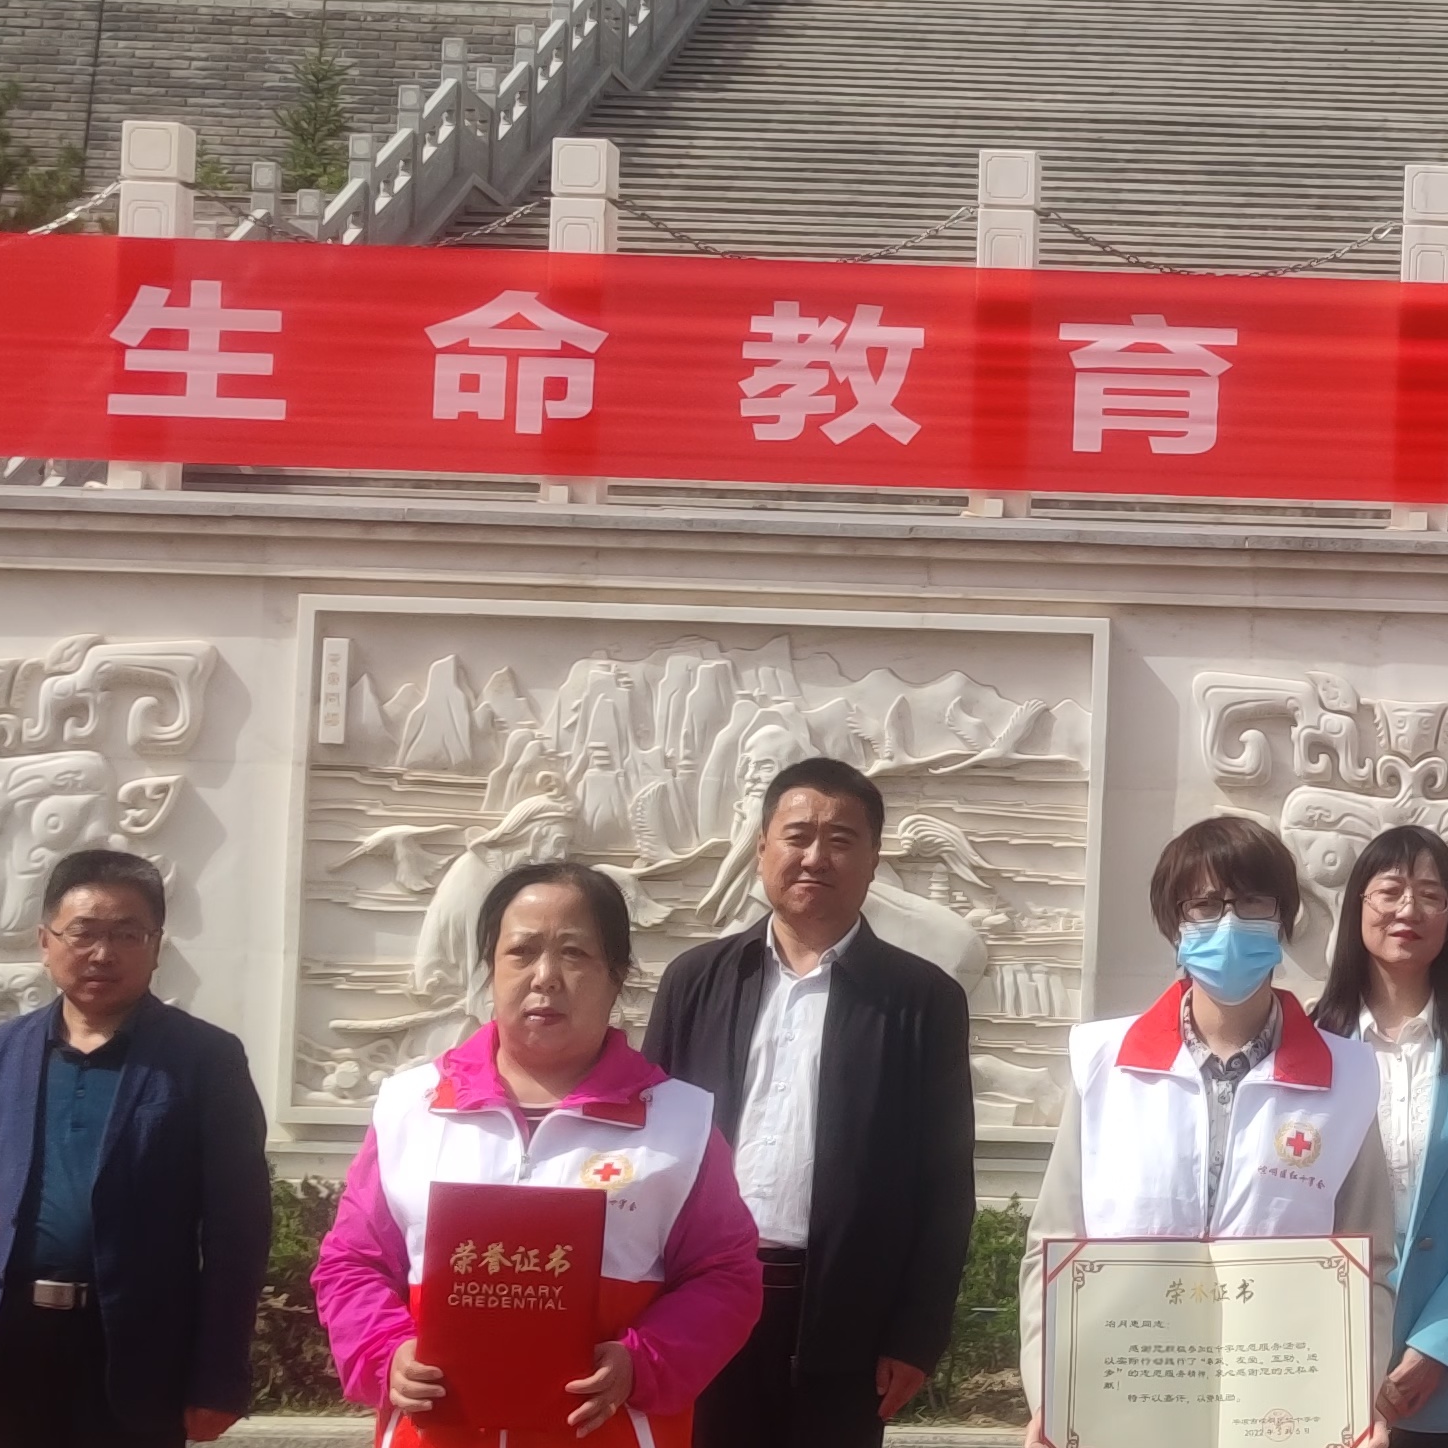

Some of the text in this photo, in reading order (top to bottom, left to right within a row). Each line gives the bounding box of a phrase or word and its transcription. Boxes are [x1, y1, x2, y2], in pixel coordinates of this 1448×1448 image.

[107, 280, 1238, 455] 生命教育
[450, 1239, 573, 1278] 荣誉证书
[447, 1294, 568, 1311] CREDENTIAL
[453, 1281, 564, 1298] HONORARY
